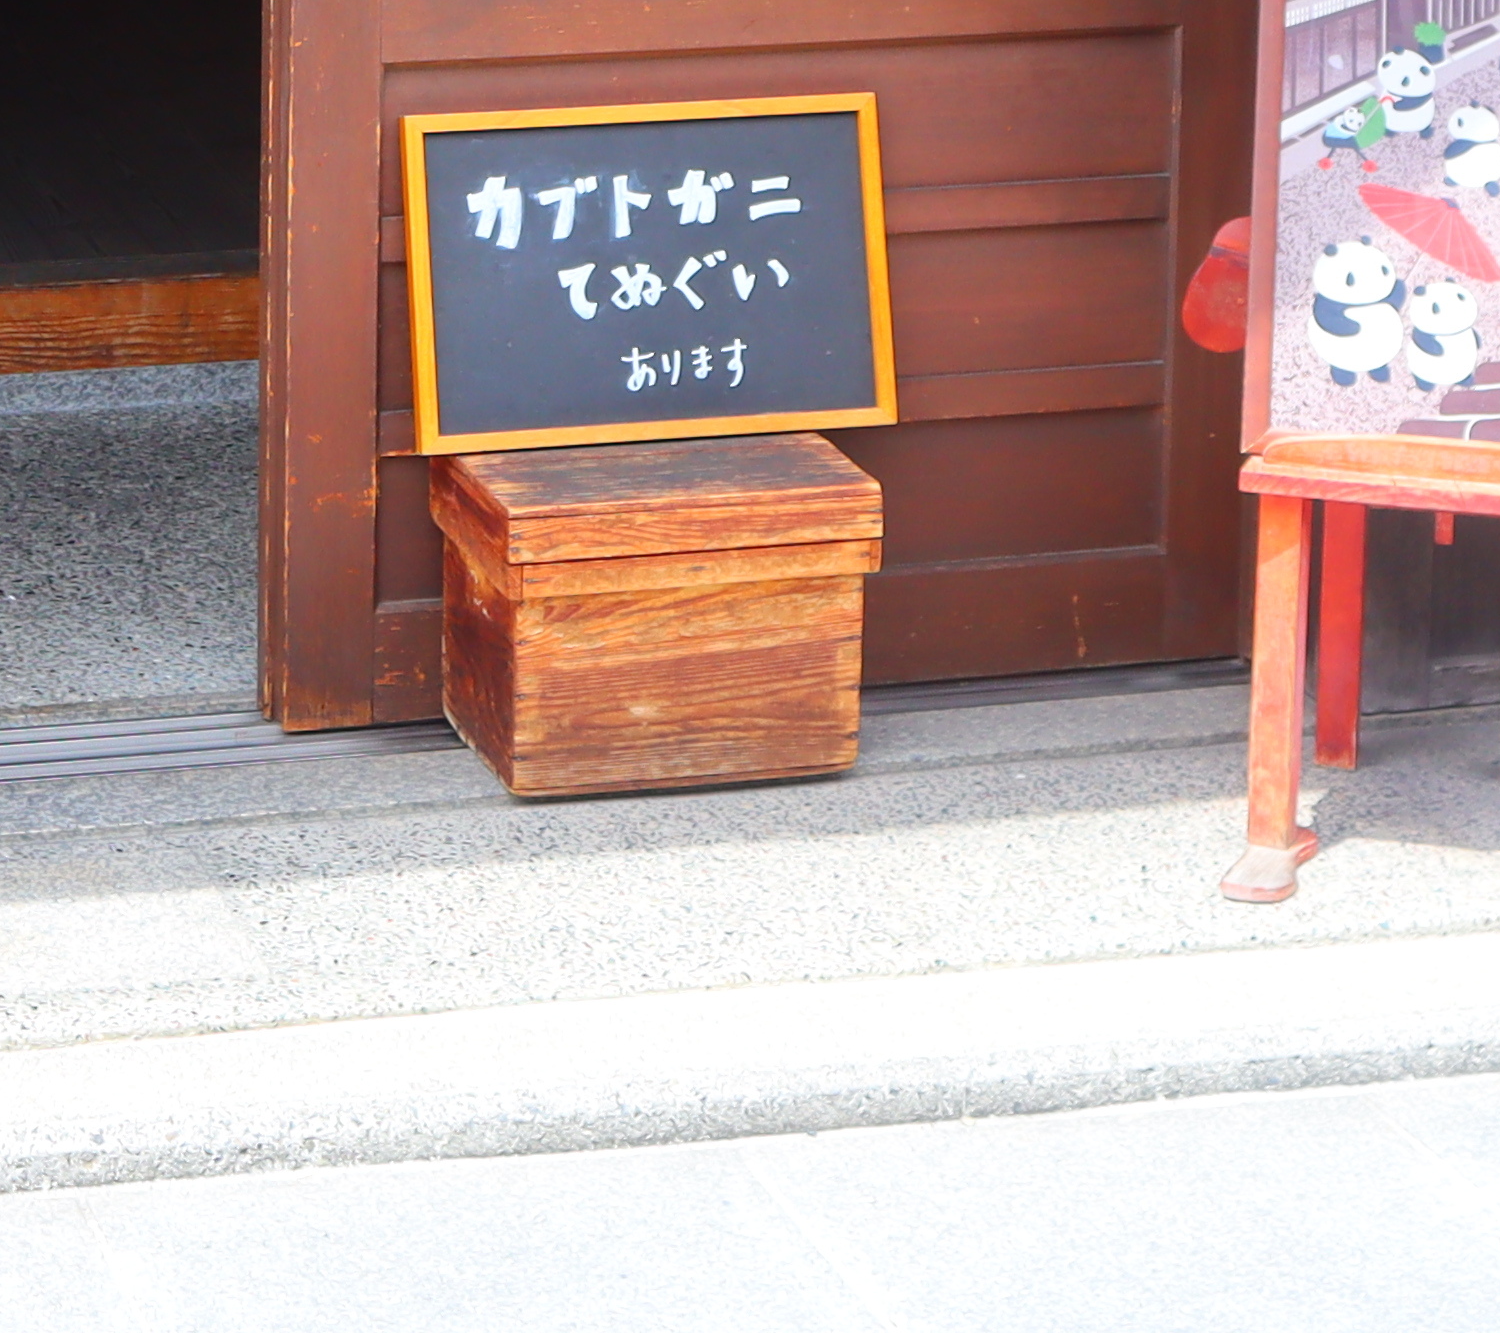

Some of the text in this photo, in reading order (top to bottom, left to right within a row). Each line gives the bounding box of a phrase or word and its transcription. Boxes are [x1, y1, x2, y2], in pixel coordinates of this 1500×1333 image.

[466, 169, 800, 250] カブトガニ
[559, 250, 790, 320] てぬぐい
[621, 338, 748, 392] あります
